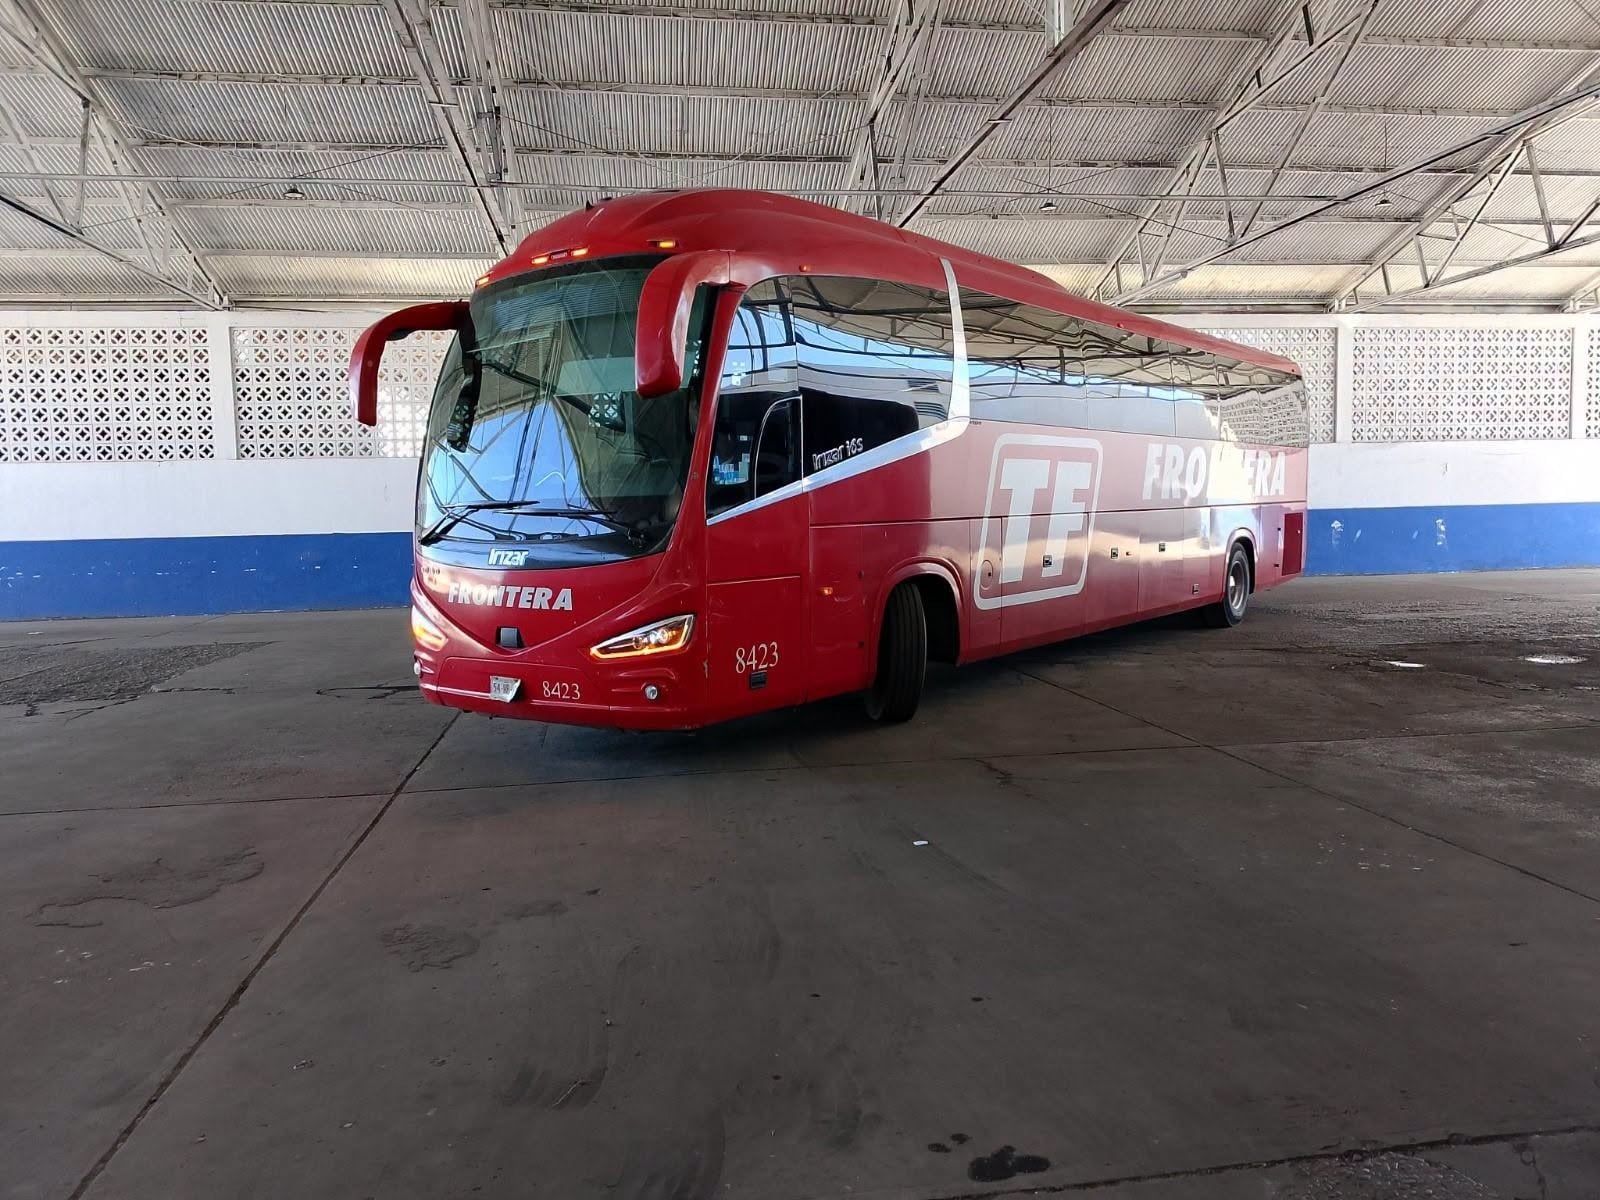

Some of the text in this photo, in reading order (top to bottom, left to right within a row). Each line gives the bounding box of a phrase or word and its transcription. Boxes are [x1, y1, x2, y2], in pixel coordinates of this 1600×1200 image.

[1142, 443, 1286, 500] FROERA
[999, 458, 1092, 584] TF
[448, 582, 573, 611] FRONTERA
[735, 641, 779, 673] 8423
[542, 680, 580, 700] 8423
